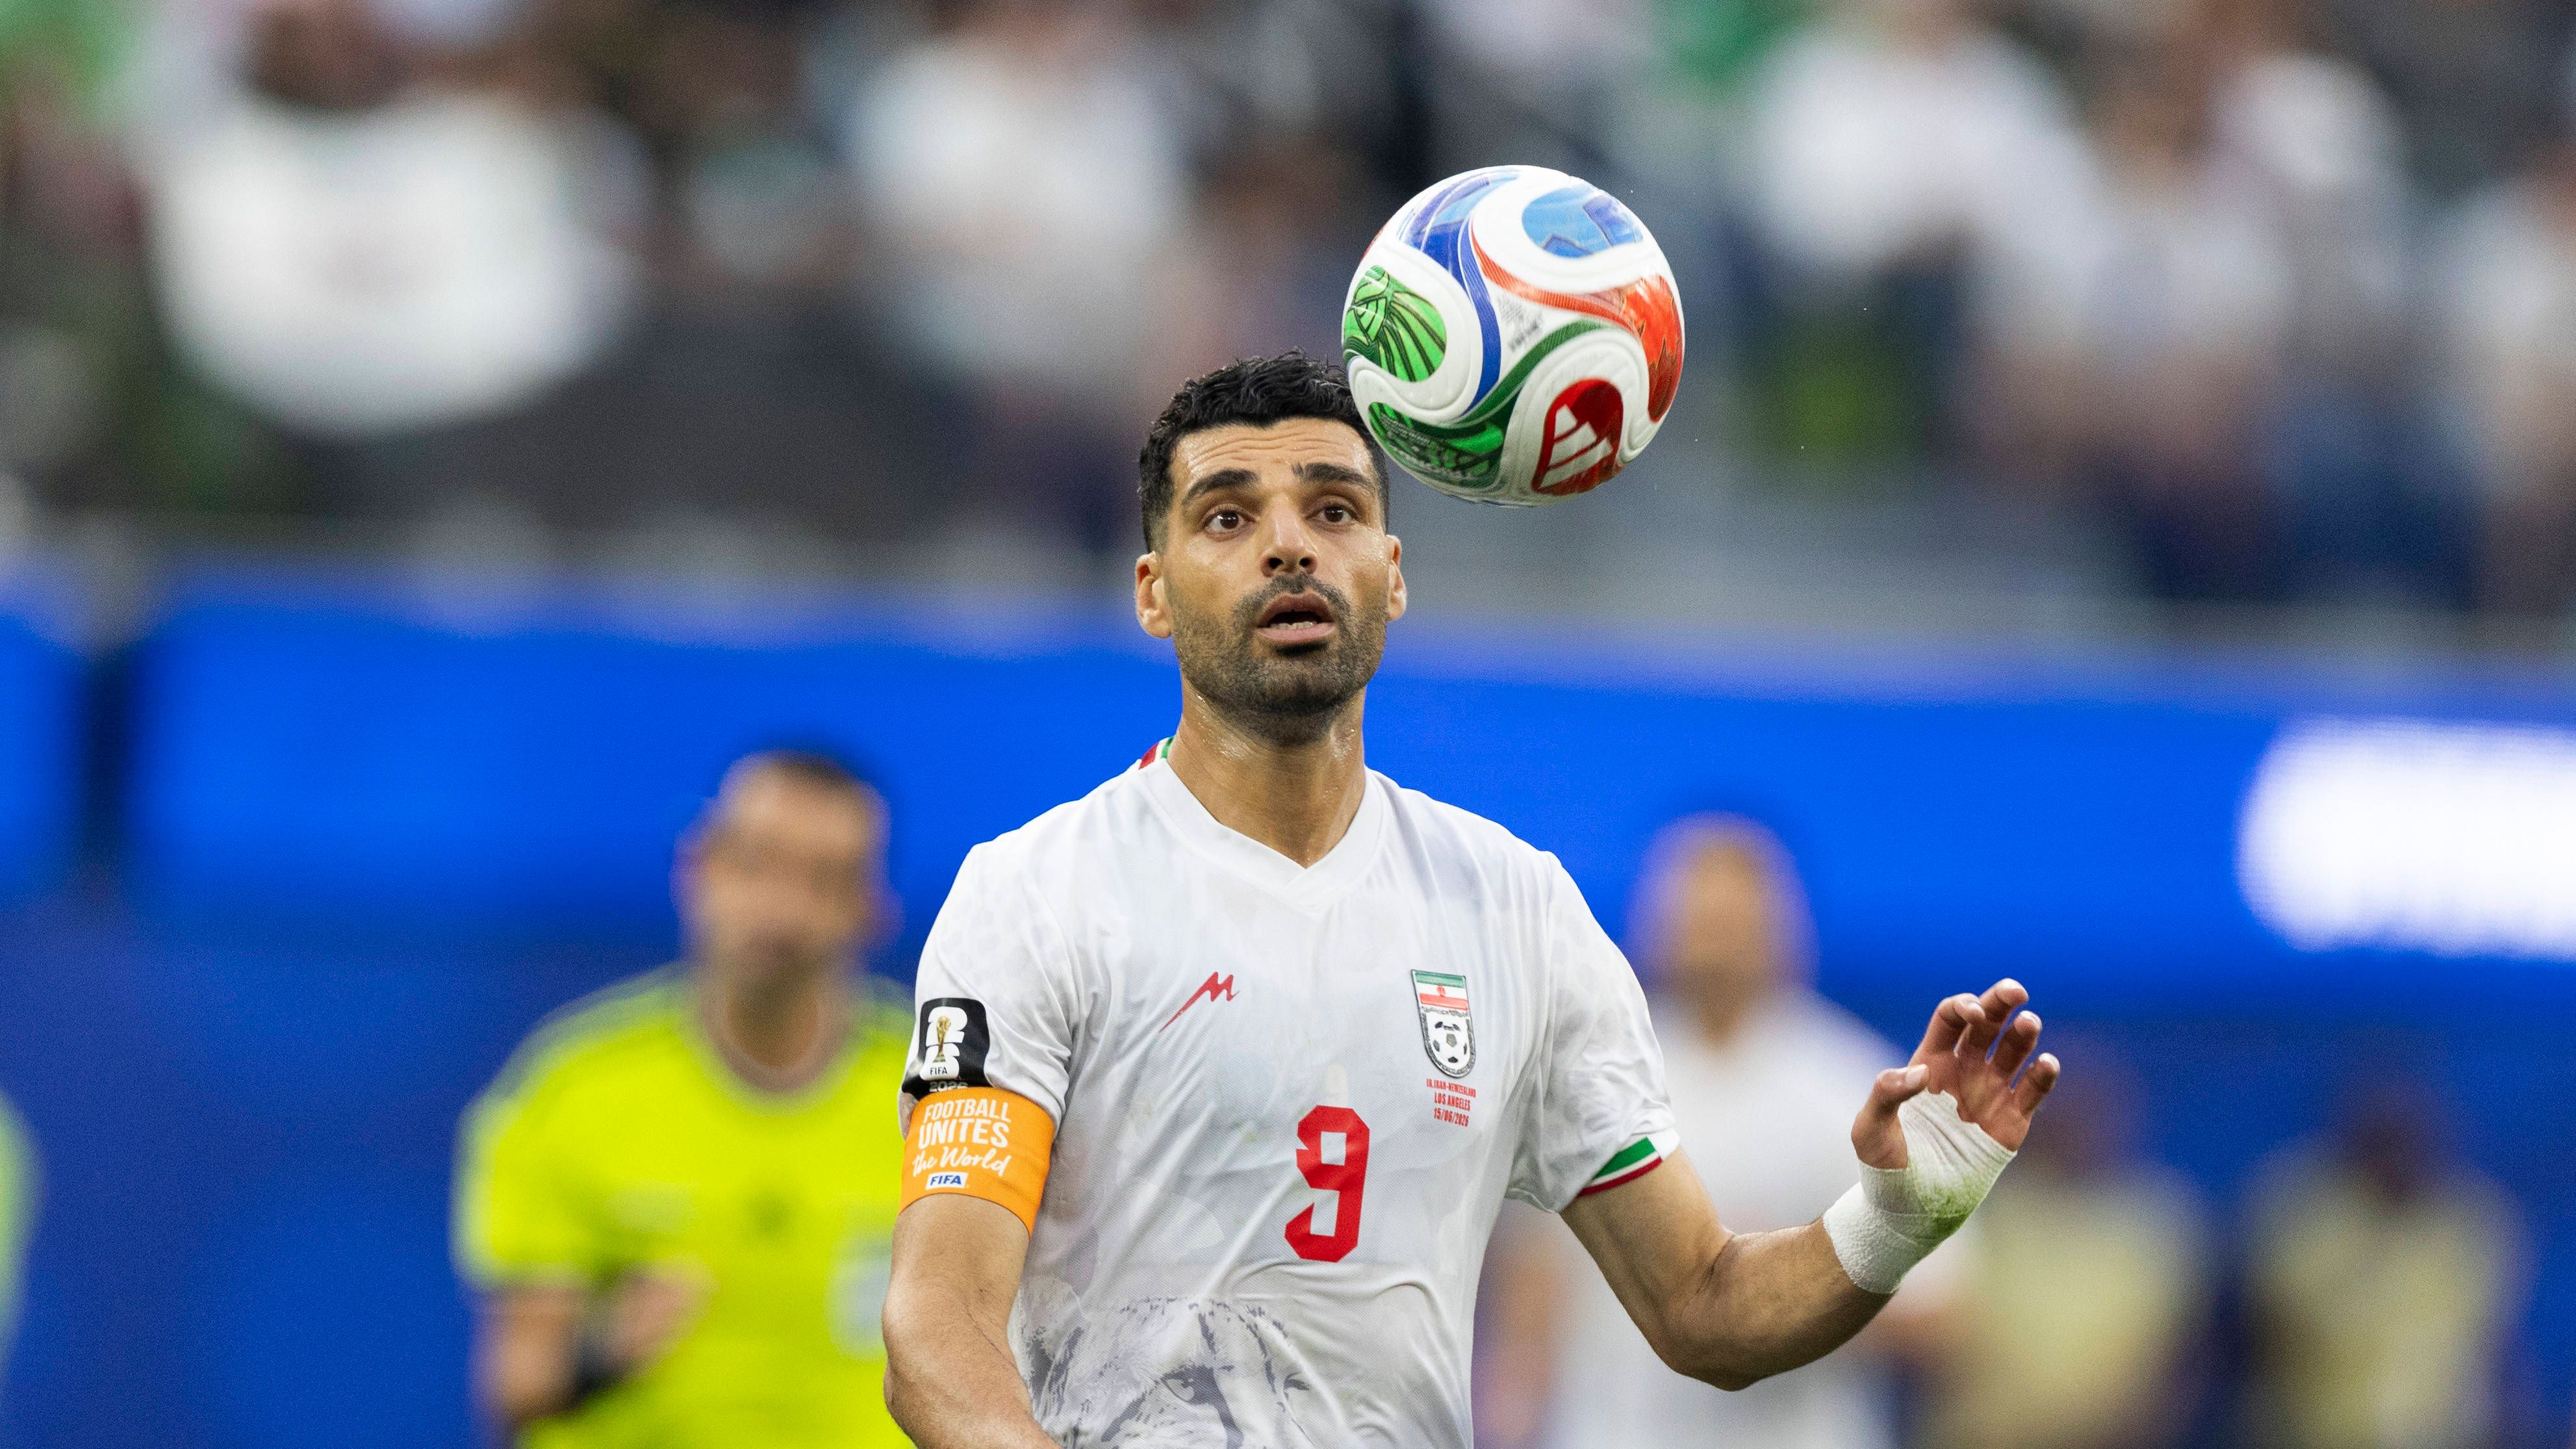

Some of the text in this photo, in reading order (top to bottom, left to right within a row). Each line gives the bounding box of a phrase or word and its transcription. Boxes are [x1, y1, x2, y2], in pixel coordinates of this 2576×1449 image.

[930, 1066, 948, 1075] FIFA
[923, 1098, 1012, 1123] FOOTBALL
[1434, 1092, 1471, 1112] LOS ANGELES
[1434, 1107, 1470, 1127] 15/06/2026
[918, 1118, 1010, 1149] UNITES
[912, 1146, 1012, 1177] the World
[930, 1175, 962, 1186] FIFA
[1284, 1105, 1370, 1263] 9
